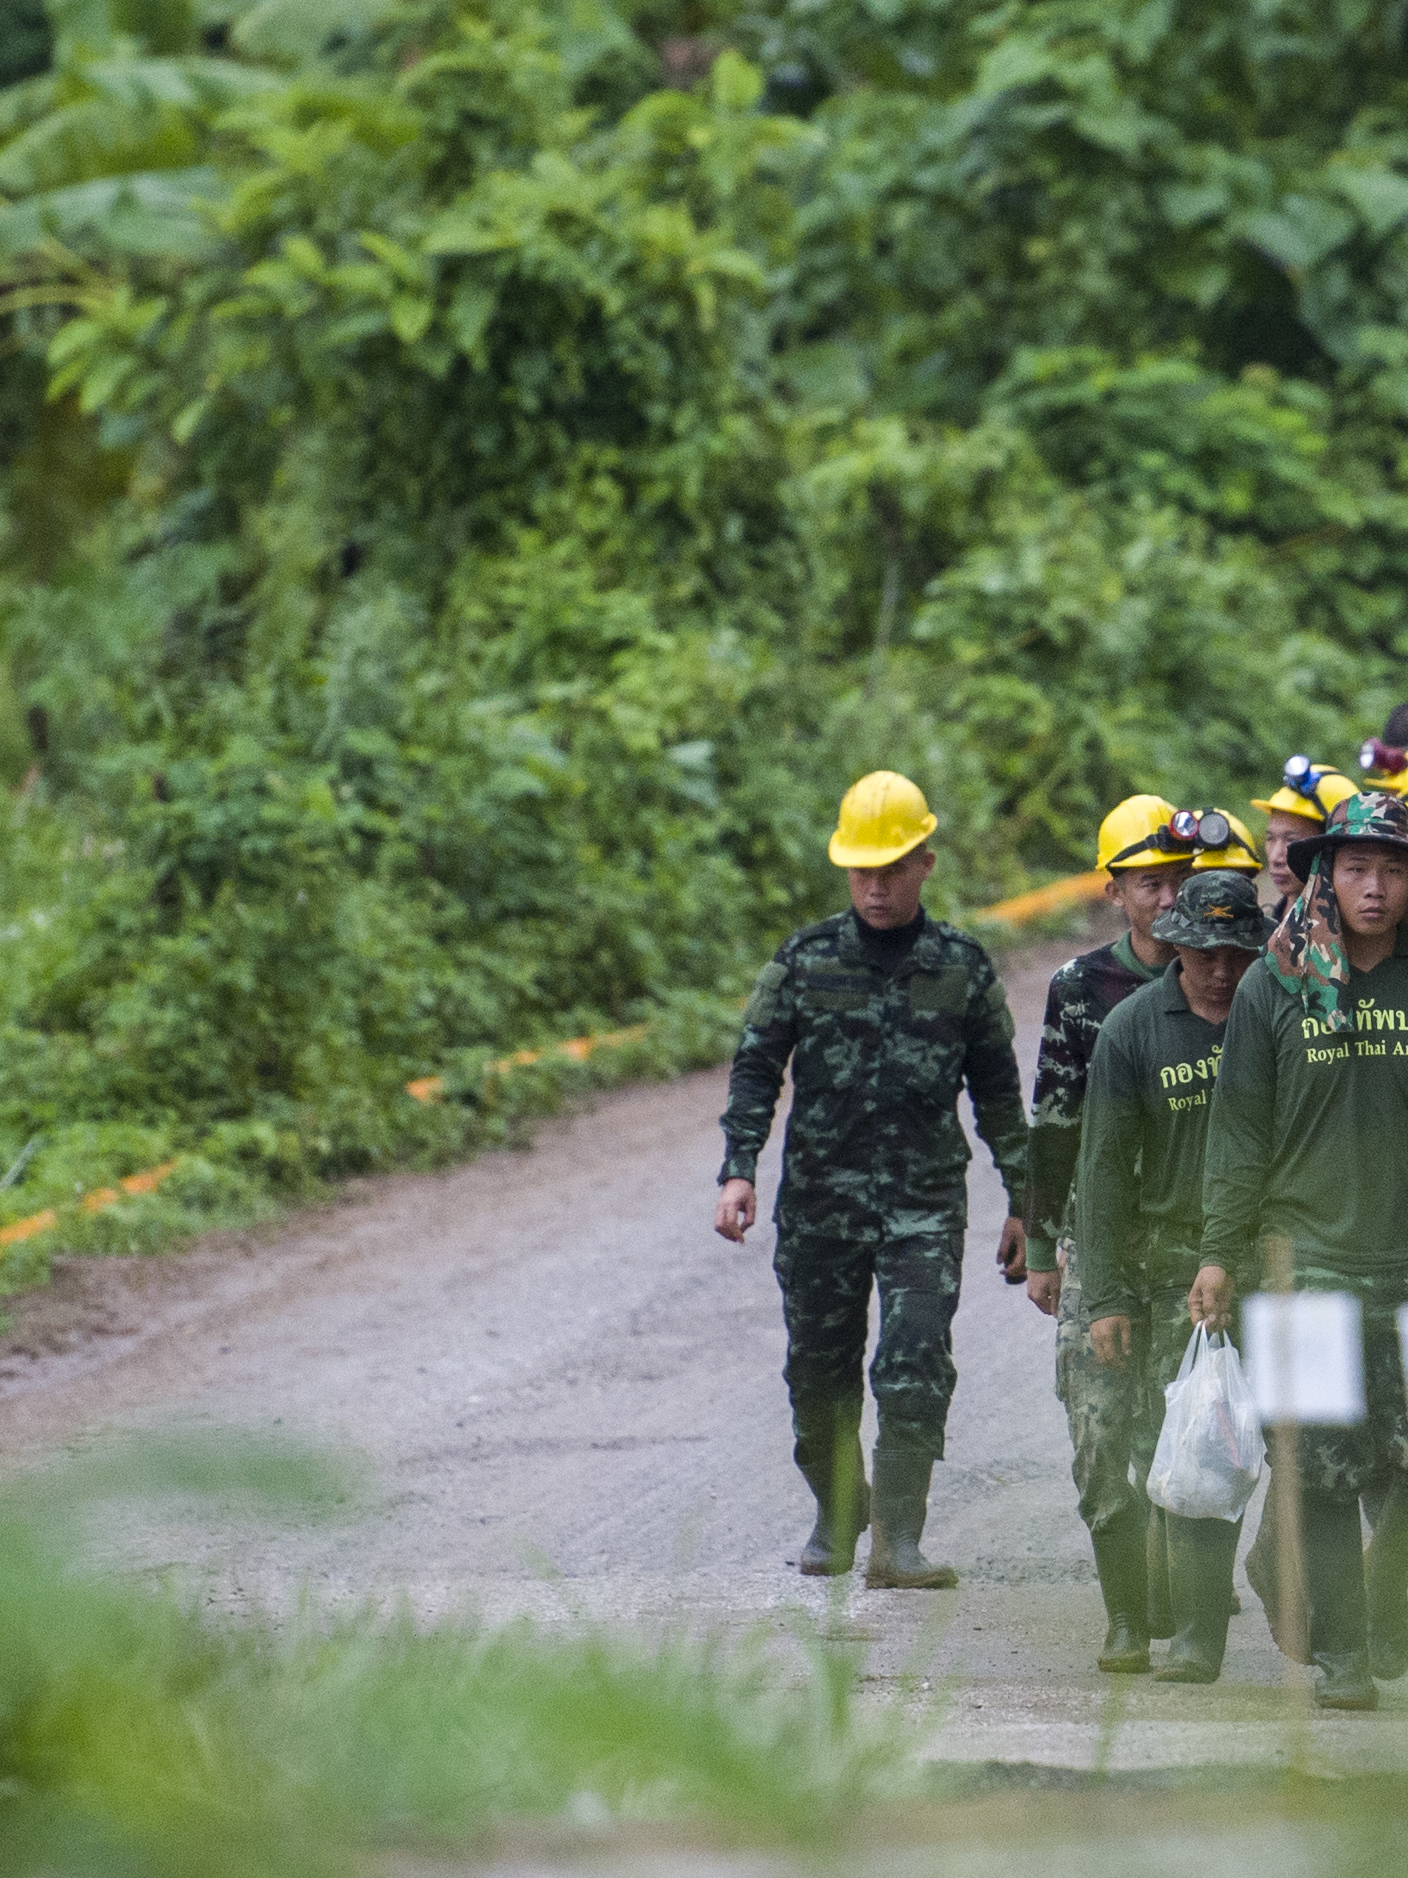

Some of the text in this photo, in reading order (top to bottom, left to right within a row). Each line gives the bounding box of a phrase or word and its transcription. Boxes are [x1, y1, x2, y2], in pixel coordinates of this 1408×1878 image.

[1306, 1042, 1350, 1065] Royal
[1355, 1040, 1387, 1056] Thai
[1168, 1089, 1207, 1112] Royal
